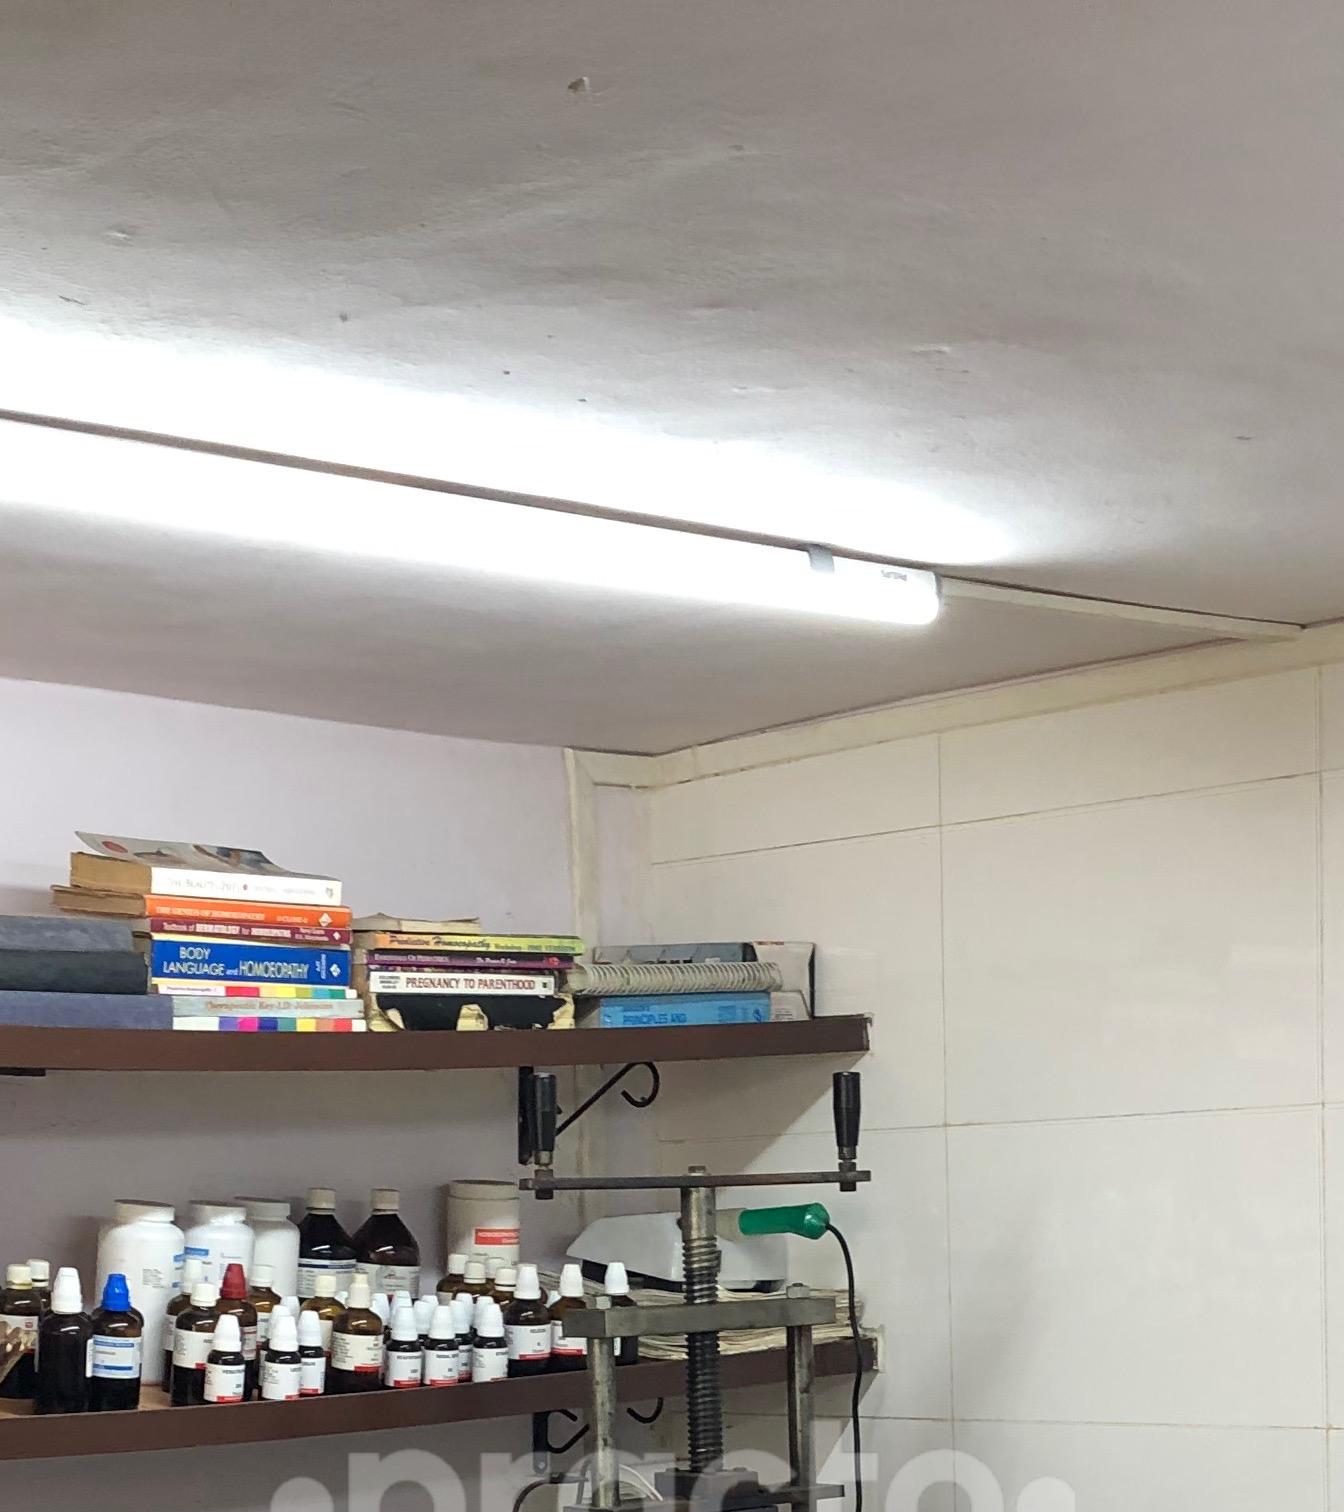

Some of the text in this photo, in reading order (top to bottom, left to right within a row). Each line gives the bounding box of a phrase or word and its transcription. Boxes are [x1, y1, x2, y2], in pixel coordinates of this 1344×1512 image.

[179, 946, 211, 960] BODY
[162, 961, 225, 977] LANGUAGE
[225, 967, 239, 976] and
[239, 960, 309, 979] HOMOEOPATHY
[405, 976, 460, 990] PREGNANCY
[463, 978, 475, 989] TO
[477, 978, 536, 990] PARENTHOOD
